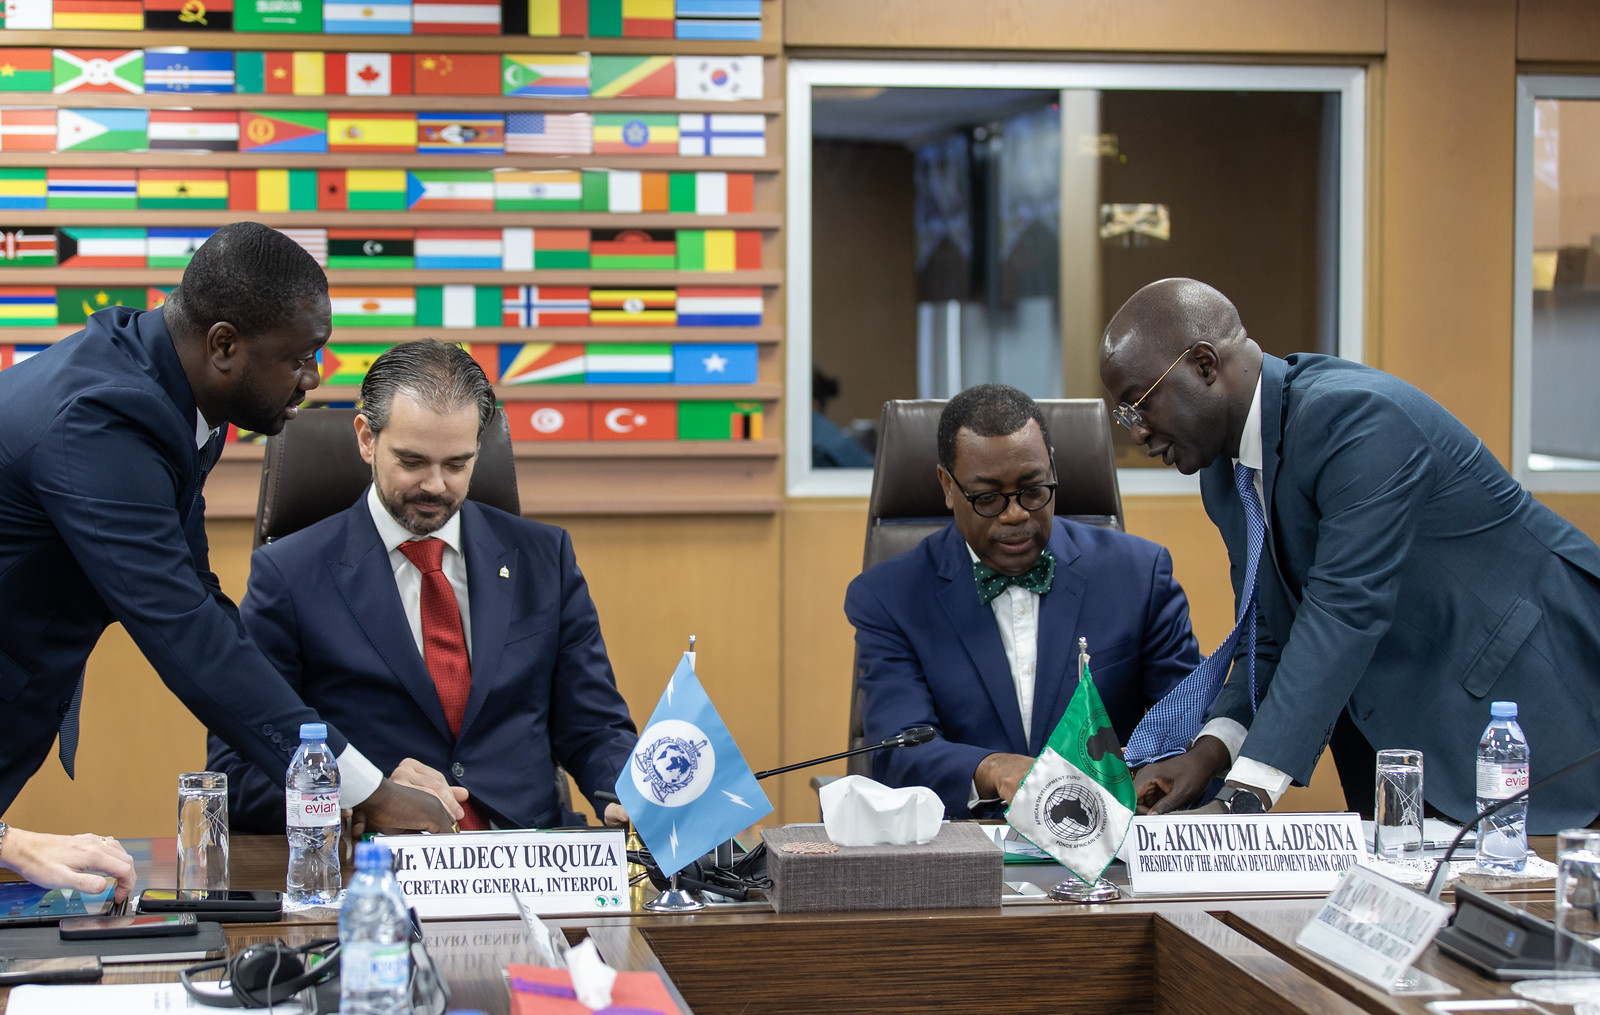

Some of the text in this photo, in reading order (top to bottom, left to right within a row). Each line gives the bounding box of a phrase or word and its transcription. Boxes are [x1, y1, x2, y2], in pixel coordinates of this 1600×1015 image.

[1037, 776, 1065, 802] DEVELOPMENT
[305, 802, 337, 814] evian
[1055, 840, 1073, 849] FONDS
[1073, 838, 1096, 849] AFRICAIN
[1135, 823, 1358, 852] Dr. AKINWUMI A.ADESINA
[421, 845, 518, 870] VALDECY
[523, 844, 618, 873] URQUIZA
[1139, 854, 1182, 872] PRESIDENT
[1184, 854, 1195, 872] OF
[1195, 854, 1213, 872] THE
[1213, 854, 1248, 872] AFRICAN
[1248, 854, 1306, 872] DEVELOPMENT
[1307, 854, 1330, 872] BANK
[397, 876, 618, 896] CRETARY GENERAL, INTERPOL
